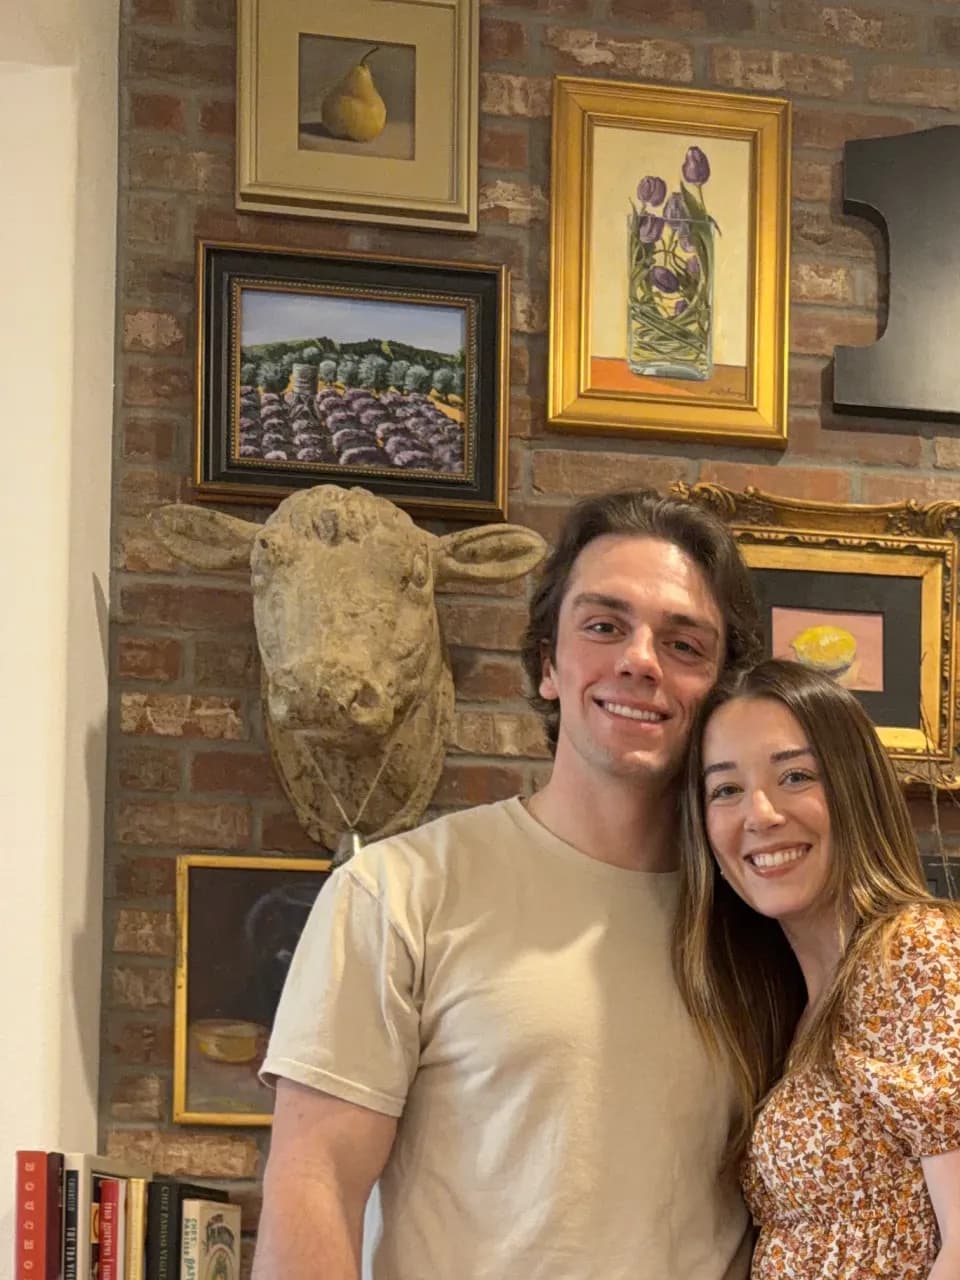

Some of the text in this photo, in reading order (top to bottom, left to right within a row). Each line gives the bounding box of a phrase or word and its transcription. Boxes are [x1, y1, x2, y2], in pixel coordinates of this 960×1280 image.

[66, 1227, 76, 1242] THE
[101, 1202, 117, 1256] ina garten
